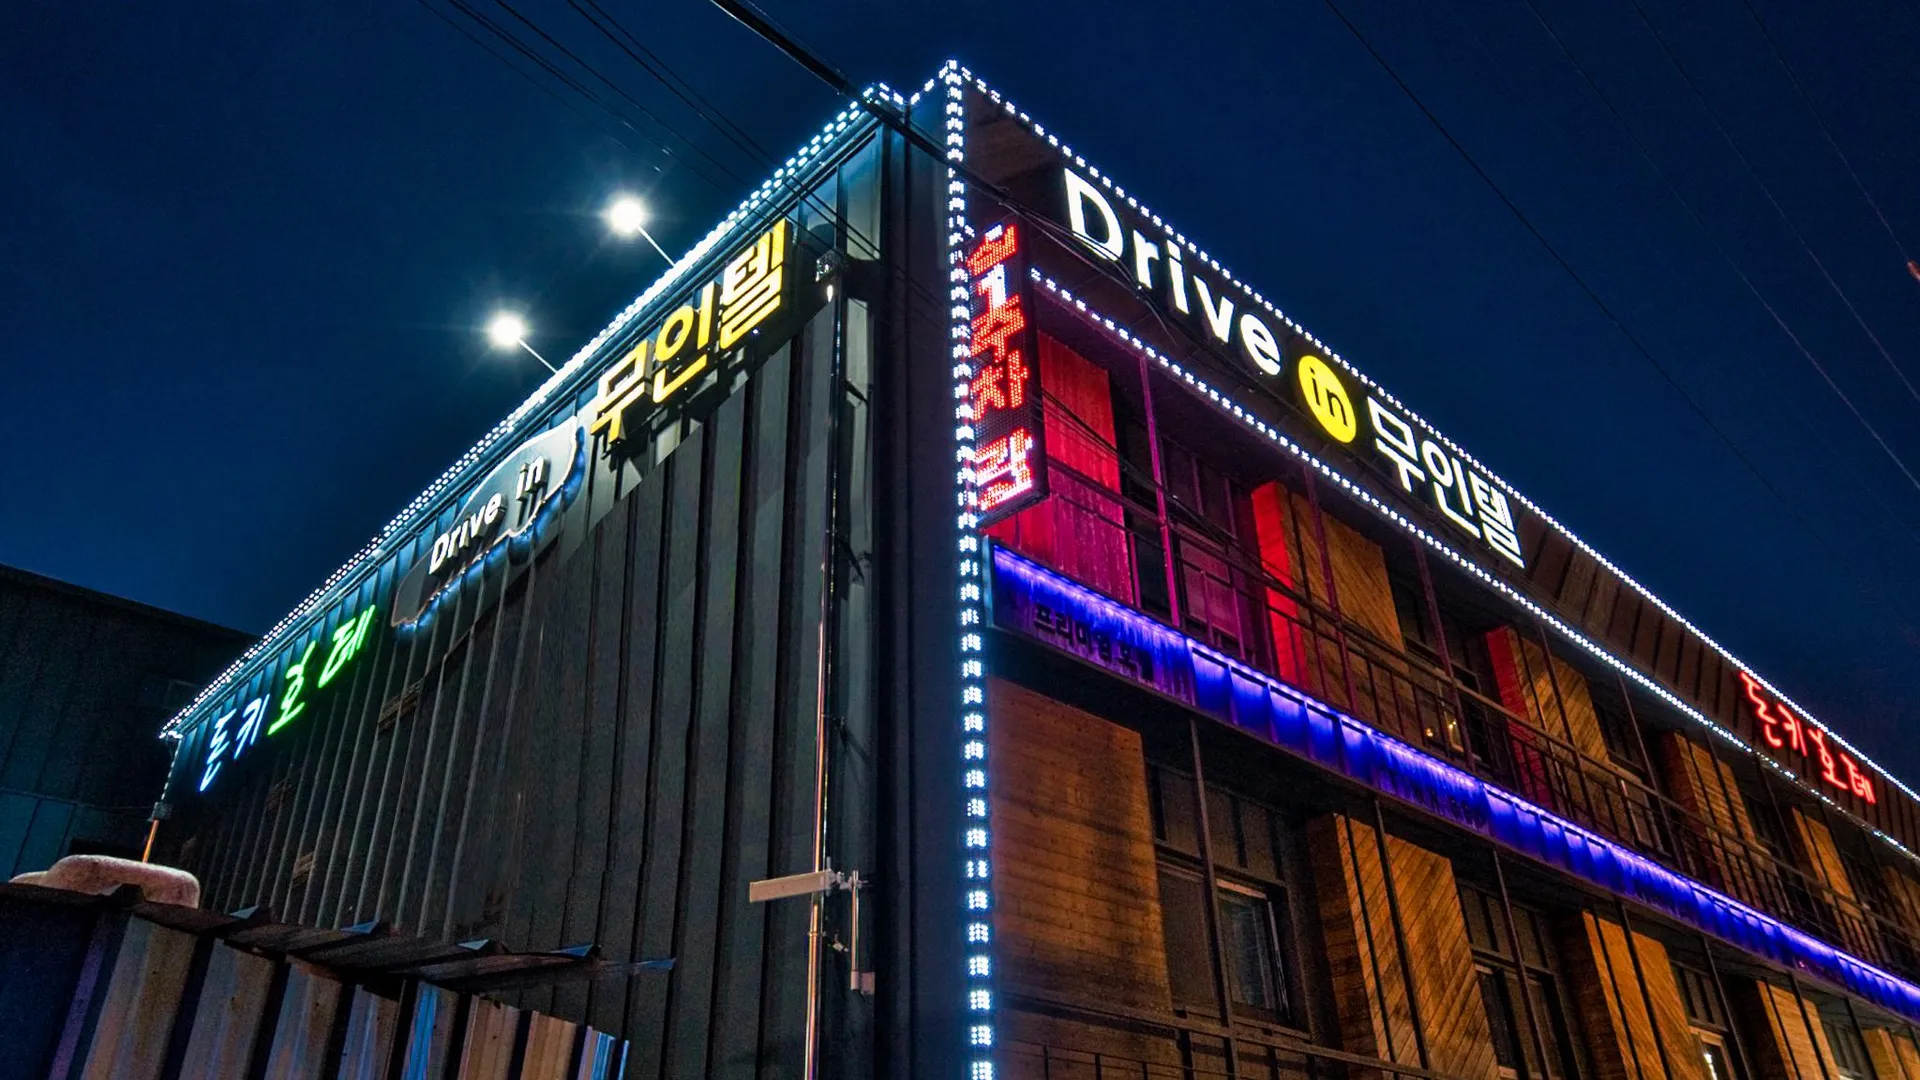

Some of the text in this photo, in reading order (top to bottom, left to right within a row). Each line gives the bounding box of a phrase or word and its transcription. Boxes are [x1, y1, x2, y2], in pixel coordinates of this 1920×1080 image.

[590, 217, 786, 444] 무인텔
[1064, 168, 1525, 570] Drive in 무인텔
[429, 455, 545, 575] Drive in
